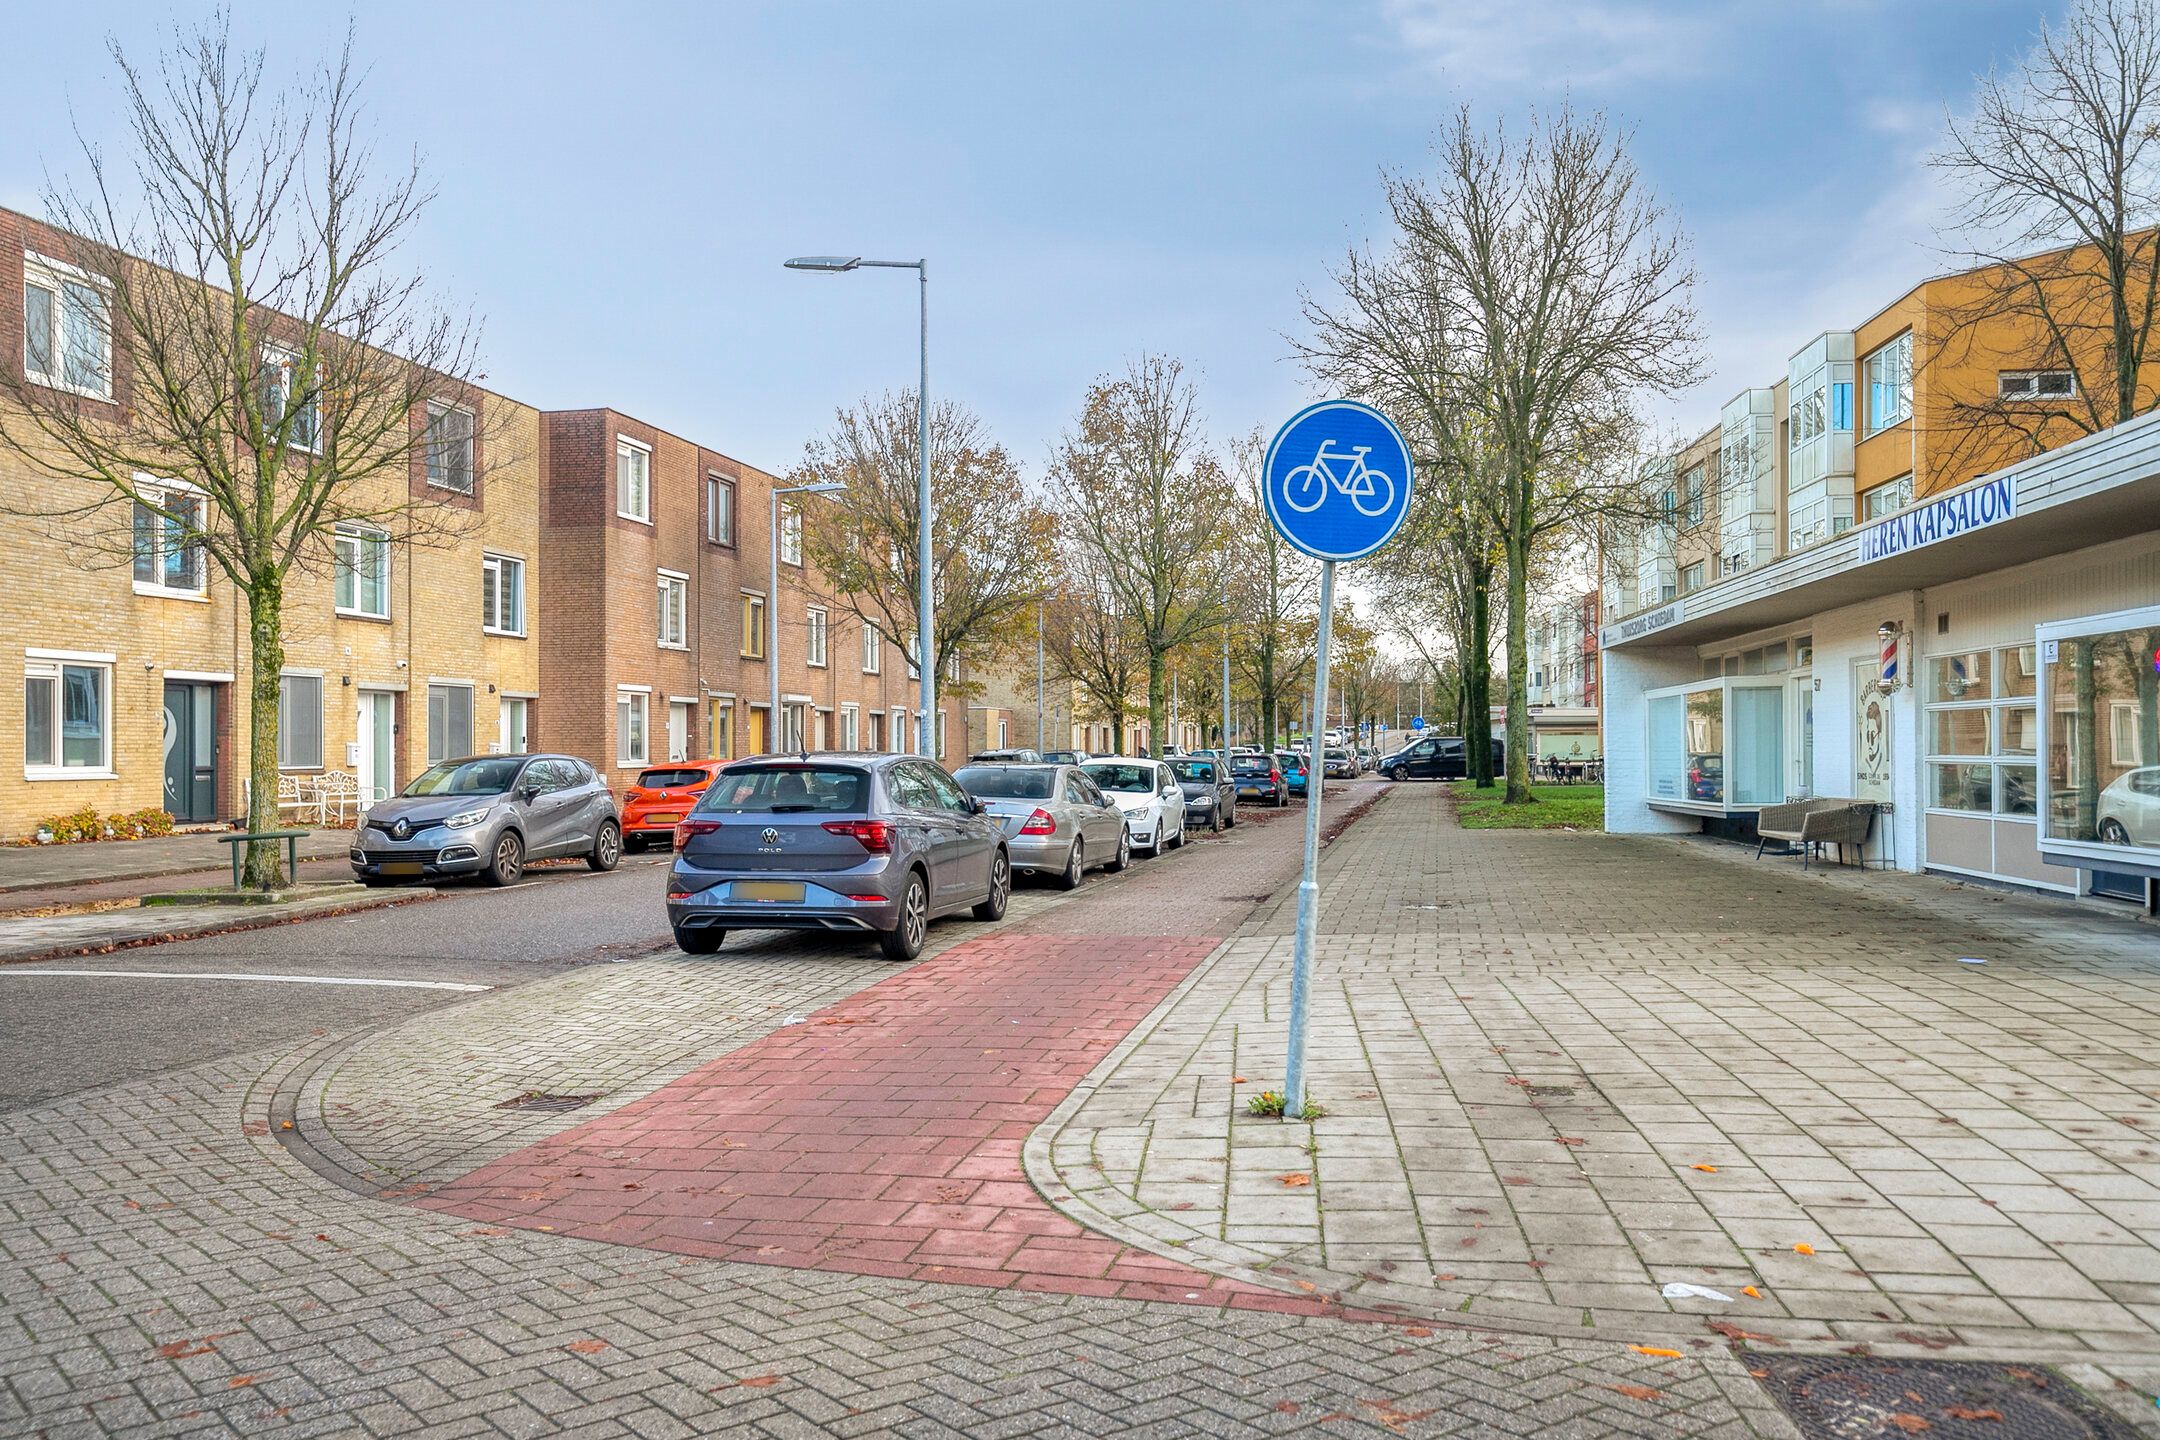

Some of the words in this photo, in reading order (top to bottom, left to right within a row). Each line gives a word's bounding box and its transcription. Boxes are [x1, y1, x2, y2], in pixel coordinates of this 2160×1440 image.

[1862, 514, 1908, 562] HEREN
[1913, 476, 2011, 546] KAPSALON
[1814, 678, 1821, 692] 57
